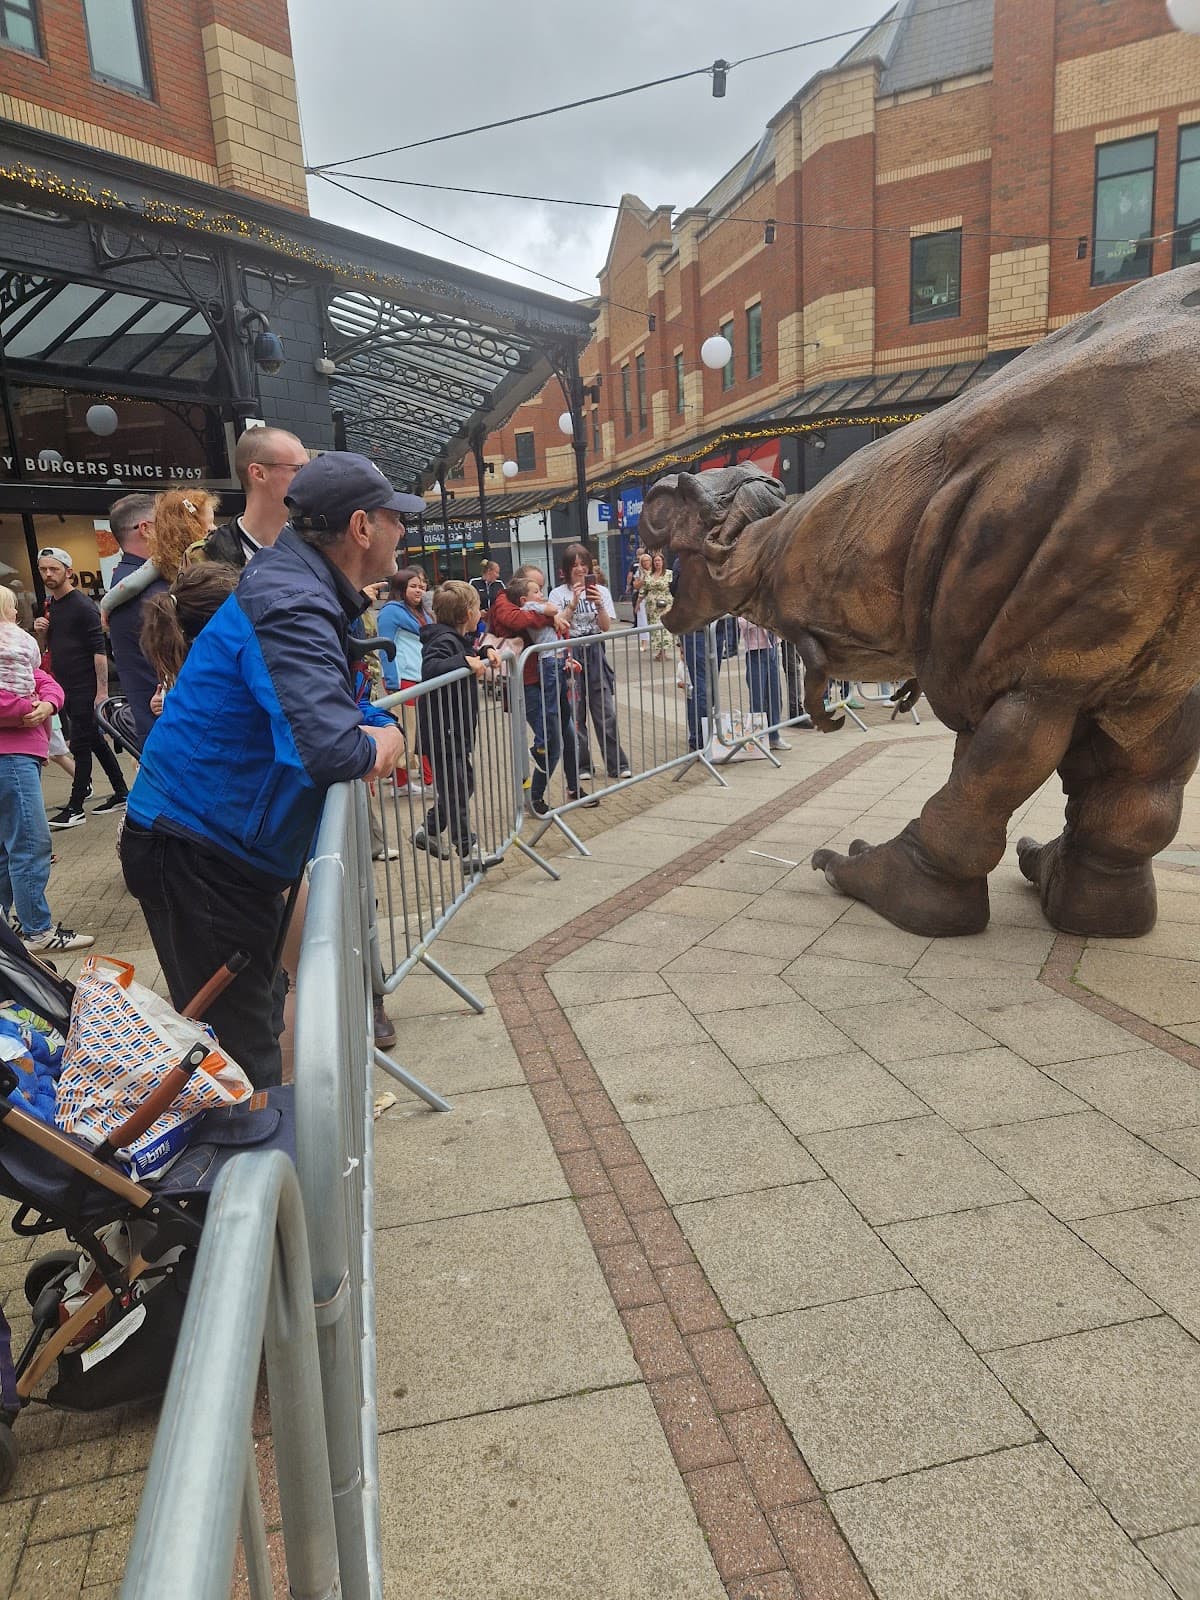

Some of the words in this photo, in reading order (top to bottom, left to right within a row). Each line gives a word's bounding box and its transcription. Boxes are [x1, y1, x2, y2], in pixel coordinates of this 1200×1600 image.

[26, 458, 108, 475] BURGERS
[114, 464, 163, 477] SINCE
[169, 467, 201, 479] 1969
[424, 533, 445, 543] 01642
